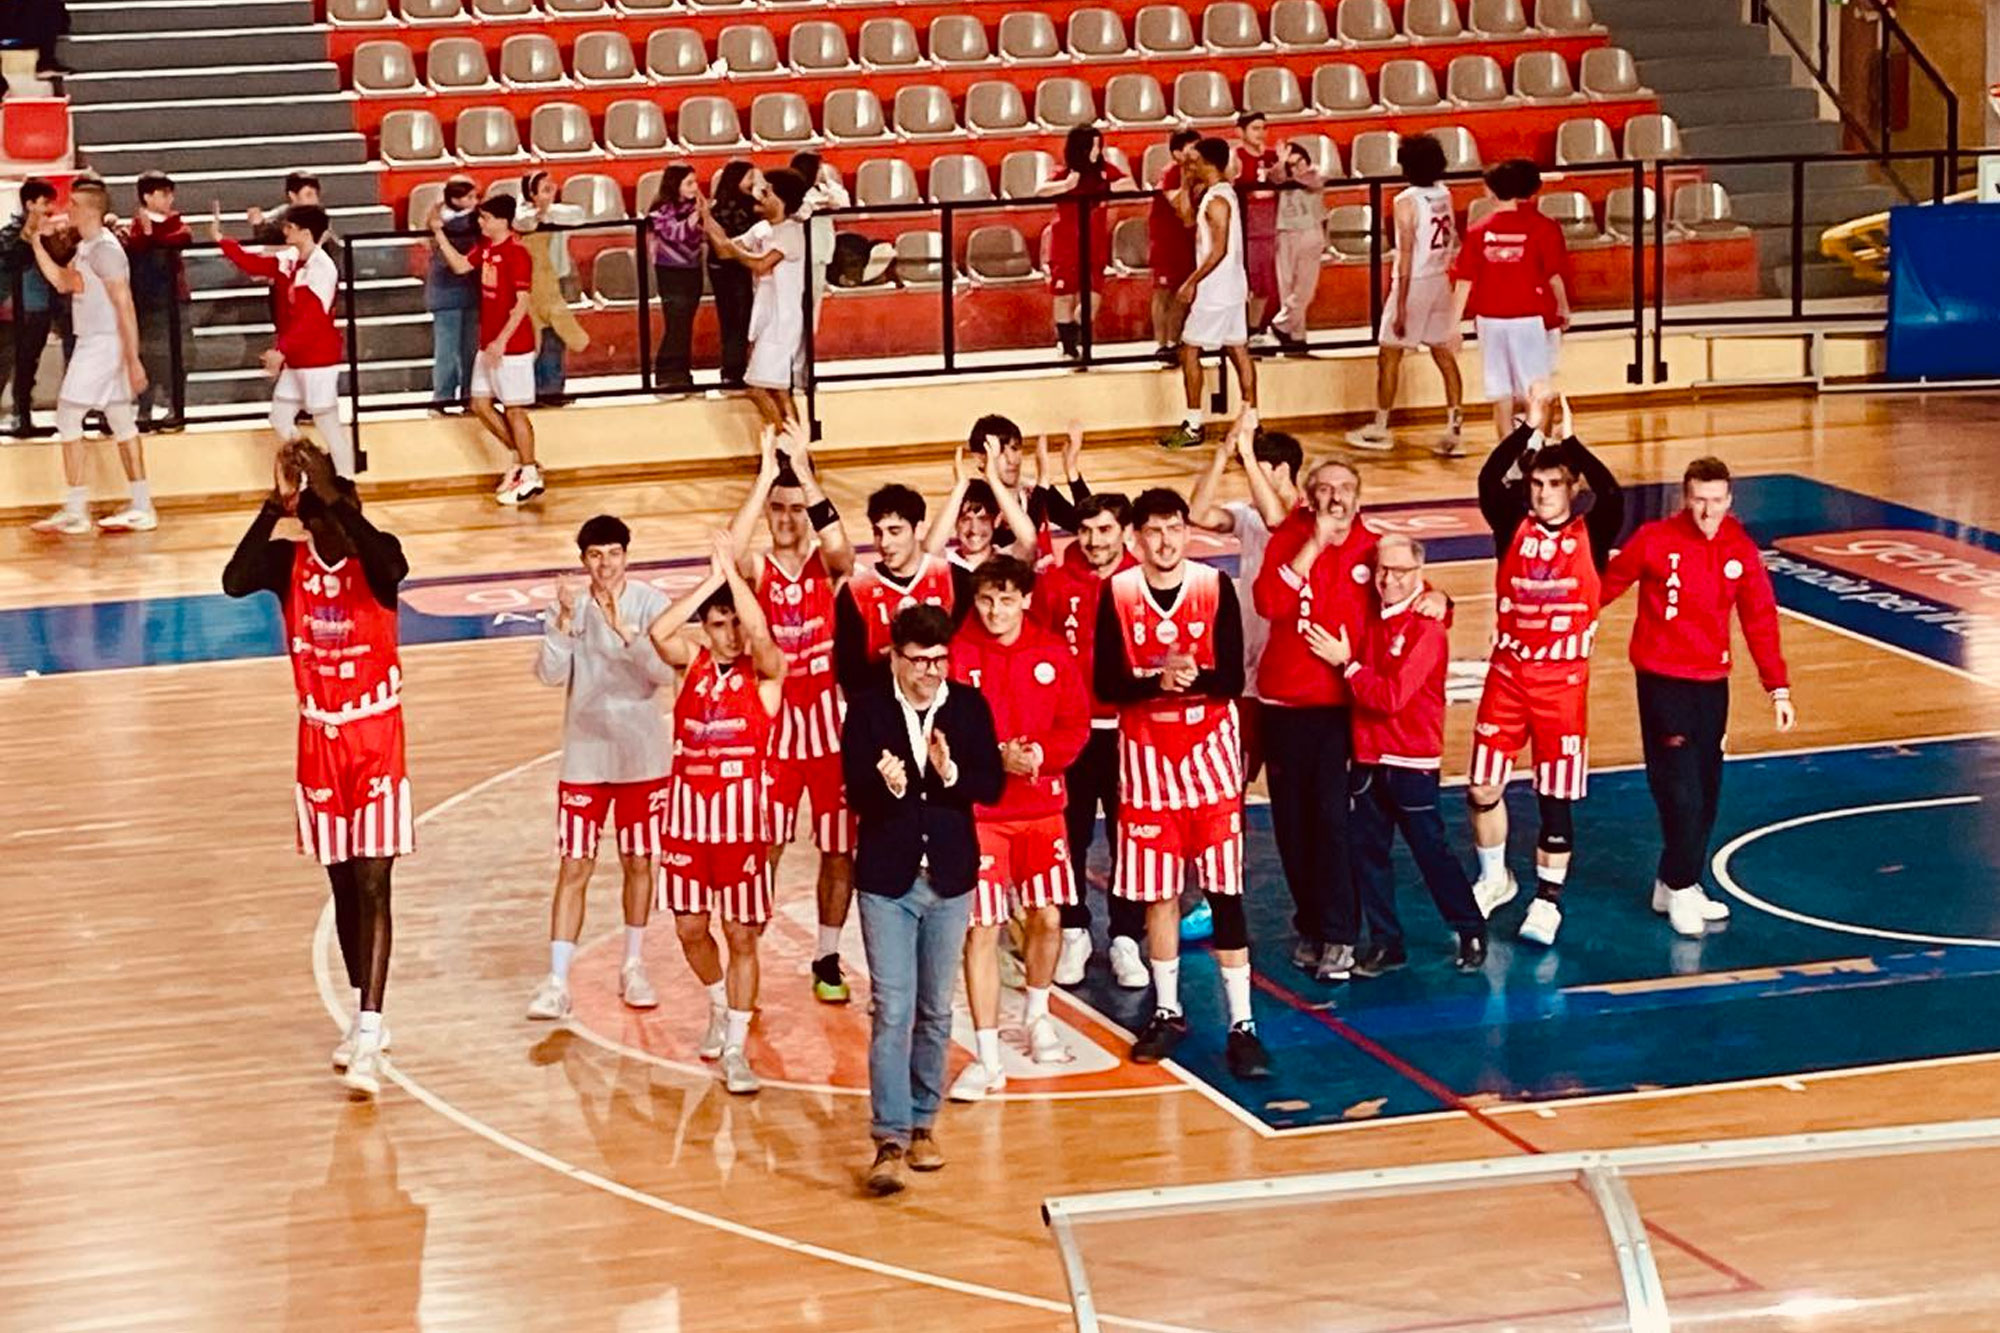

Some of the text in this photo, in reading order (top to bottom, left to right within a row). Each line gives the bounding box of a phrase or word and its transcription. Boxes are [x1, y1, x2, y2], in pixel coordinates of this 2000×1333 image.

[1297, 583, 1314, 634] ASP
[1560, 734, 1582, 756] 10
[367, 775, 393, 798] 34
[743, 854, 757, 876] 4
